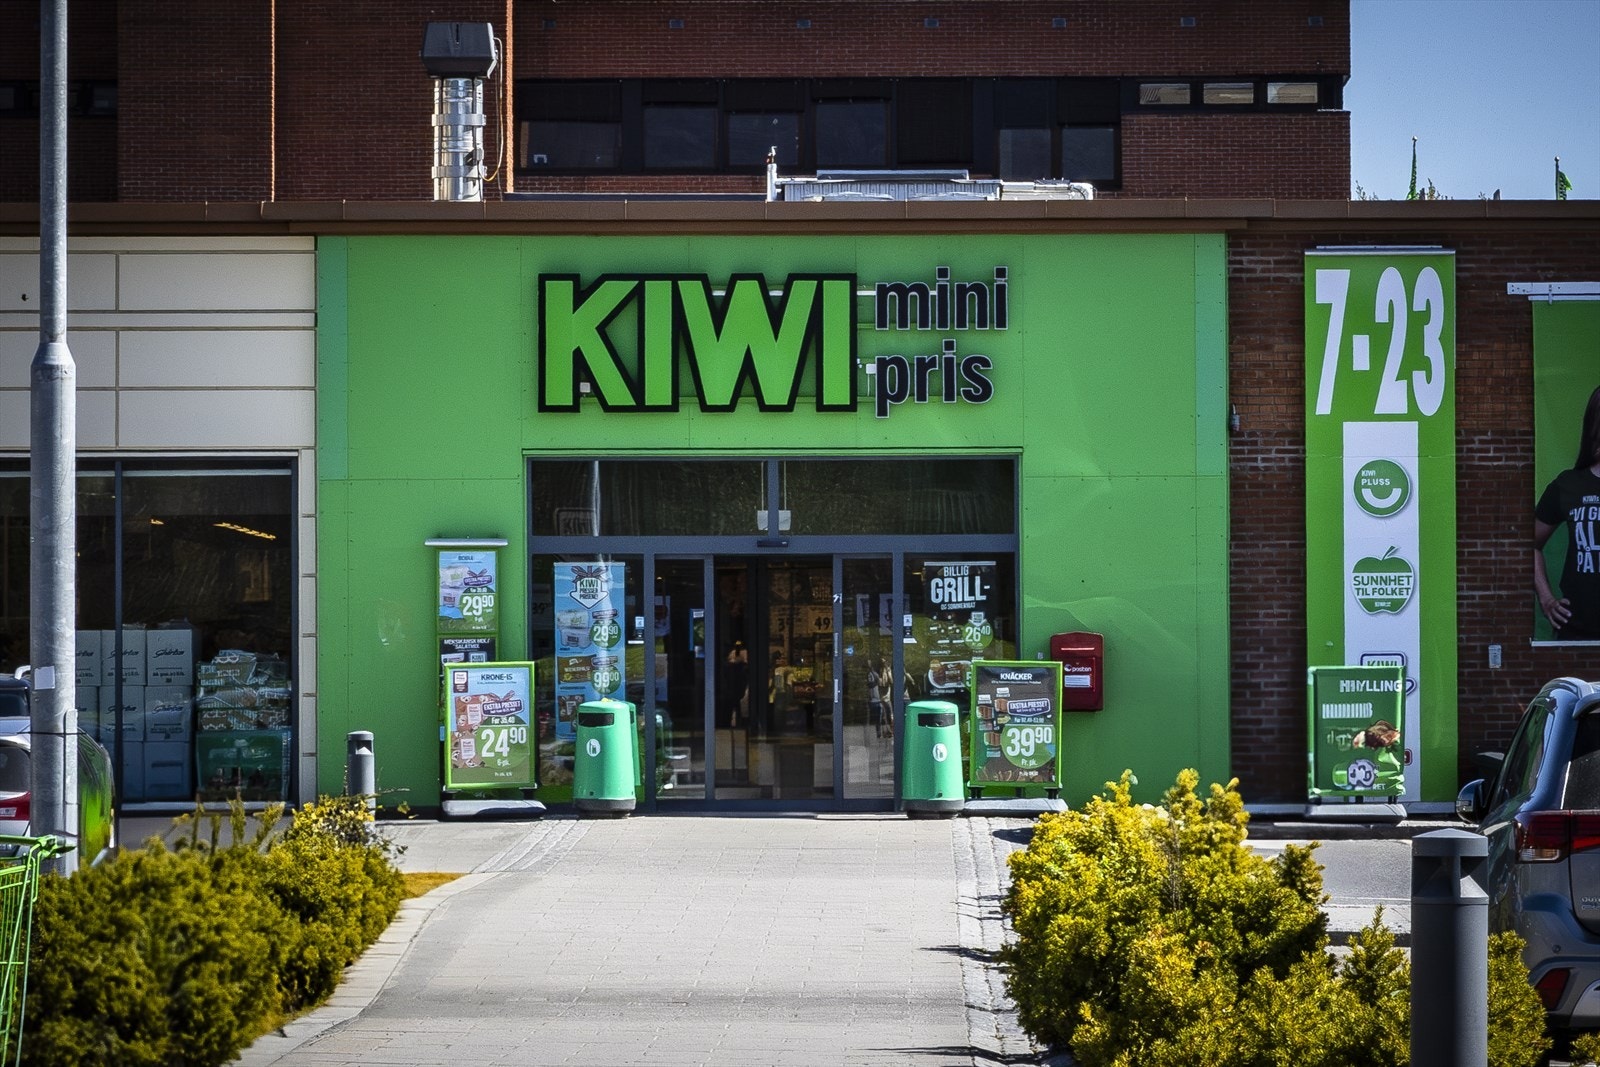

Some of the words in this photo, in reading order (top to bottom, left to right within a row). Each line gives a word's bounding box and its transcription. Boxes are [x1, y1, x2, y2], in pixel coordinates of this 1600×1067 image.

[874, 266, 1008, 331] mini
[538, 273, 857, 413] KIWI
[1315, 266, 1446, 417] 7-23
[874, 339, 995, 419] pris
[1361, 478, 1391, 486] PLUSS
[943, 565, 969, 577] BILLIG
[1577, 546, 1595, 573] PÅ
[580, 579, 599, 588] KIWI
[930, 575, 991, 603] GRILL-
[1353, 575, 1413, 586] SUNNHET
[1355, 587, 1370, 596] TIL
[1372, 587, 1411, 596] FOLKET
